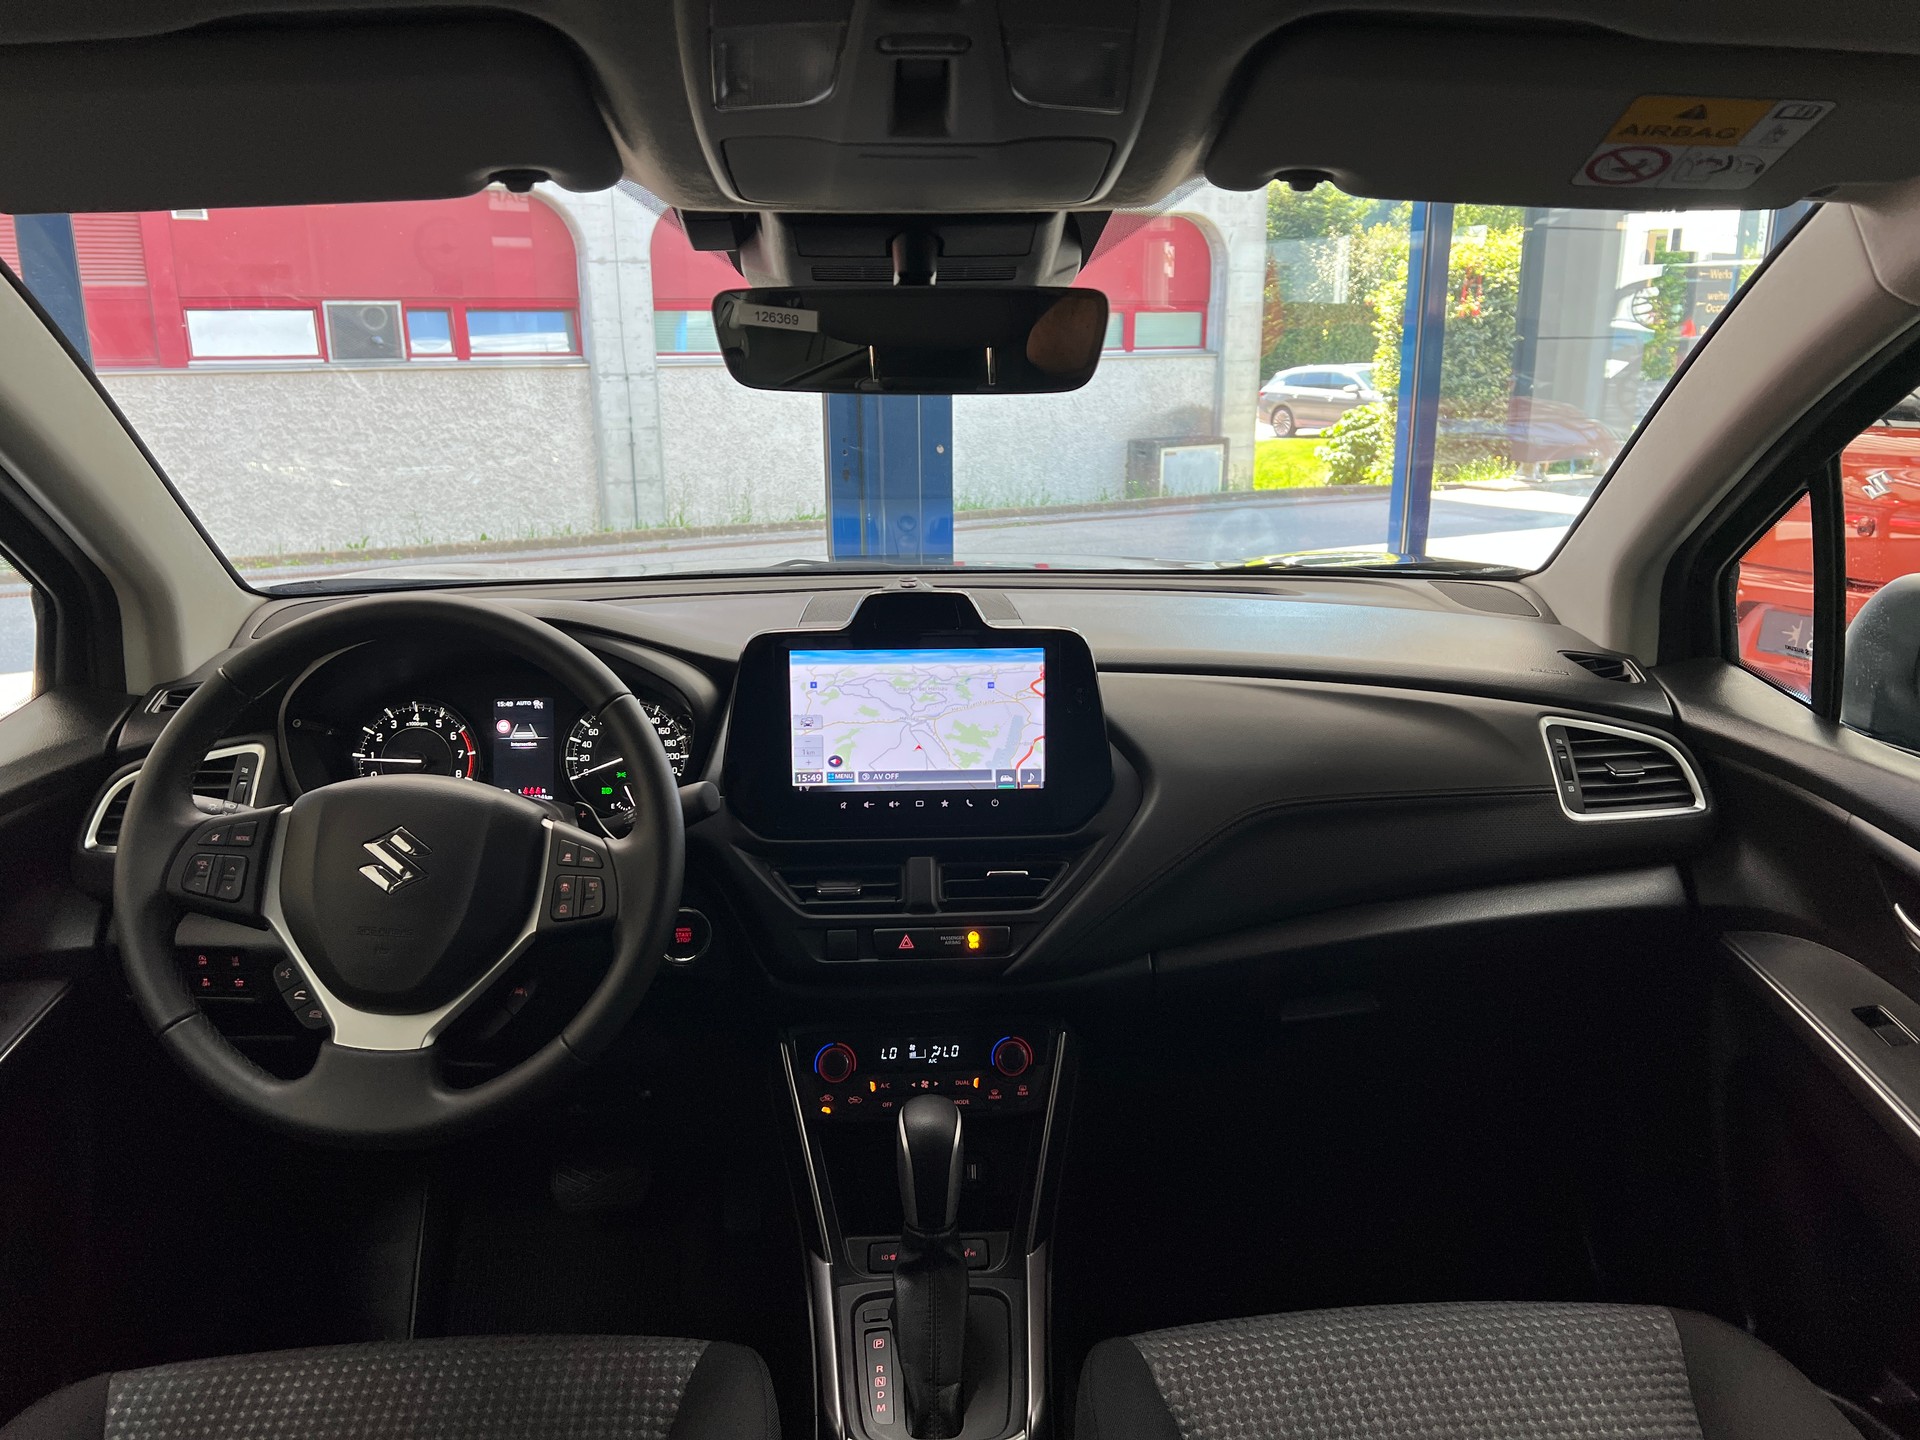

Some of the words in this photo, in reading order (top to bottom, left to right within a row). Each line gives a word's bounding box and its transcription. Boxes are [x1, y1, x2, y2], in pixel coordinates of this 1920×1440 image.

[1617, 123, 1737, 138] AIRBAG
[754, 311, 799, 325] 126369
[413, 713, 420, 721] 4
[390, 720, 397, 729] 3
[435, 719, 442, 728] 5
[588, 728, 599, 736] 60
[658, 727, 671, 735] 160
[376, 733, 383, 742] 2
[450, 732, 457, 740] 6
[581, 740, 592, 749] 40
[663, 739, 677, 747] 180
[370, 751, 375, 759] 1
[457, 750, 464, 758] 7
[579, 754, 590, 762] 20
[455, 769, 462, 778] 8
[796, 773, 822, 782] 15:49
[885, 772, 899, 780] OFF
[880, 1046, 898, 1060] LO
[942, 1044, 959, 1058] LO
[876, 1365, 884, 1373] R
[877, 1377, 884, 1386] N
[877, 1391, 885, 1399] D
[876, 1403, 886, 1412] M
